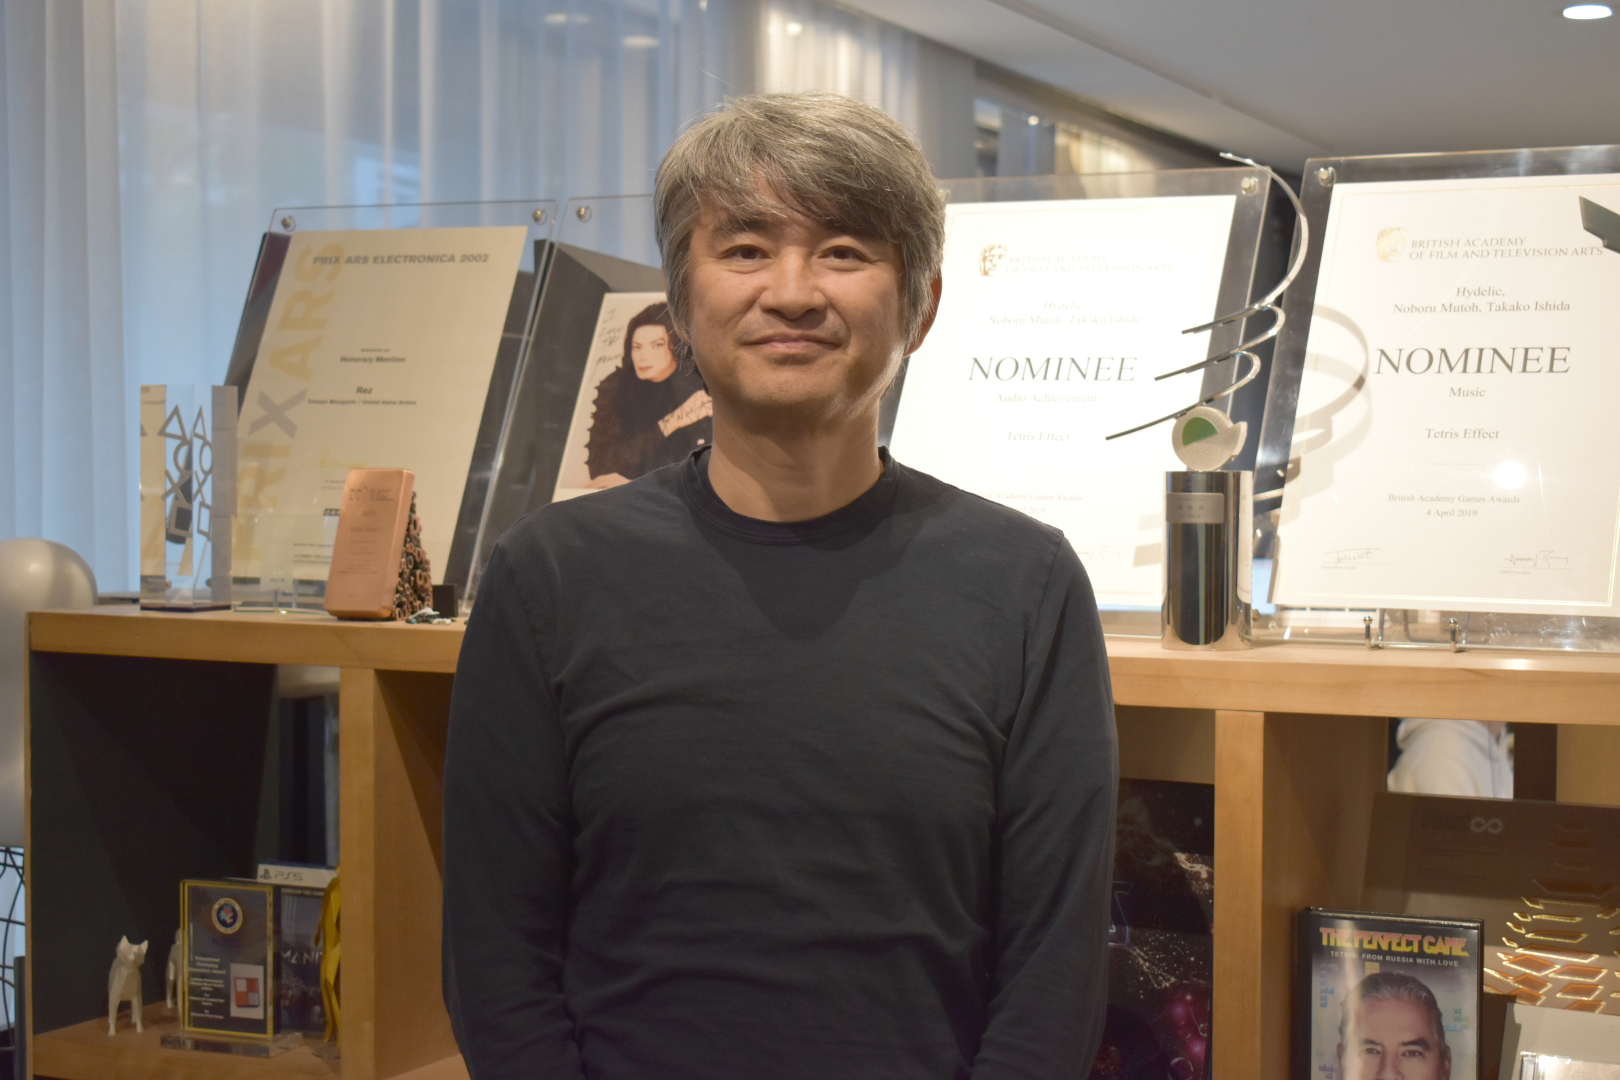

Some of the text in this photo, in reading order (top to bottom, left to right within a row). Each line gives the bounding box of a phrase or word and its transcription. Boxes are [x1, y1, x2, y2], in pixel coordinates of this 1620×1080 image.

[1411, 237, 1527, 249] BRITISH ACADEMY
[312, 253, 490, 265] PRIX ARS ELECTRONICA 2002
[1409, 247, 1604, 260] OF FILM AND TELEVISION ARTS
[1455, 286, 1505, 299] Hydelic,
[268, 242, 346, 383] ARS
[1393, 301, 1571, 314] Noboru Mutoh, Takako Ishida
[375, 356, 406, 364] Mention
[1373, 346, 1571, 375] NOMINEE
[966, 356, 1138, 382] NOMINEE
[356, 386, 374, 395] Rez
[1448, 387, 1486, 398] Music
[994, 392, 1026, 403] Audio
[1425, 428, 1500, 439] Tetris Effect
[1388, 494, 1520, 504] British Academy Games Awards
[1426, 508, 1478, 519] 4 April 2019
[274, 870, 303, 881] PS5
[1319, 927, 1470, 957] THE PERFECT GAME
[1385, 956, 1414, 964] RUSSIA
[1438, 959, 1459, 967] LOVE
